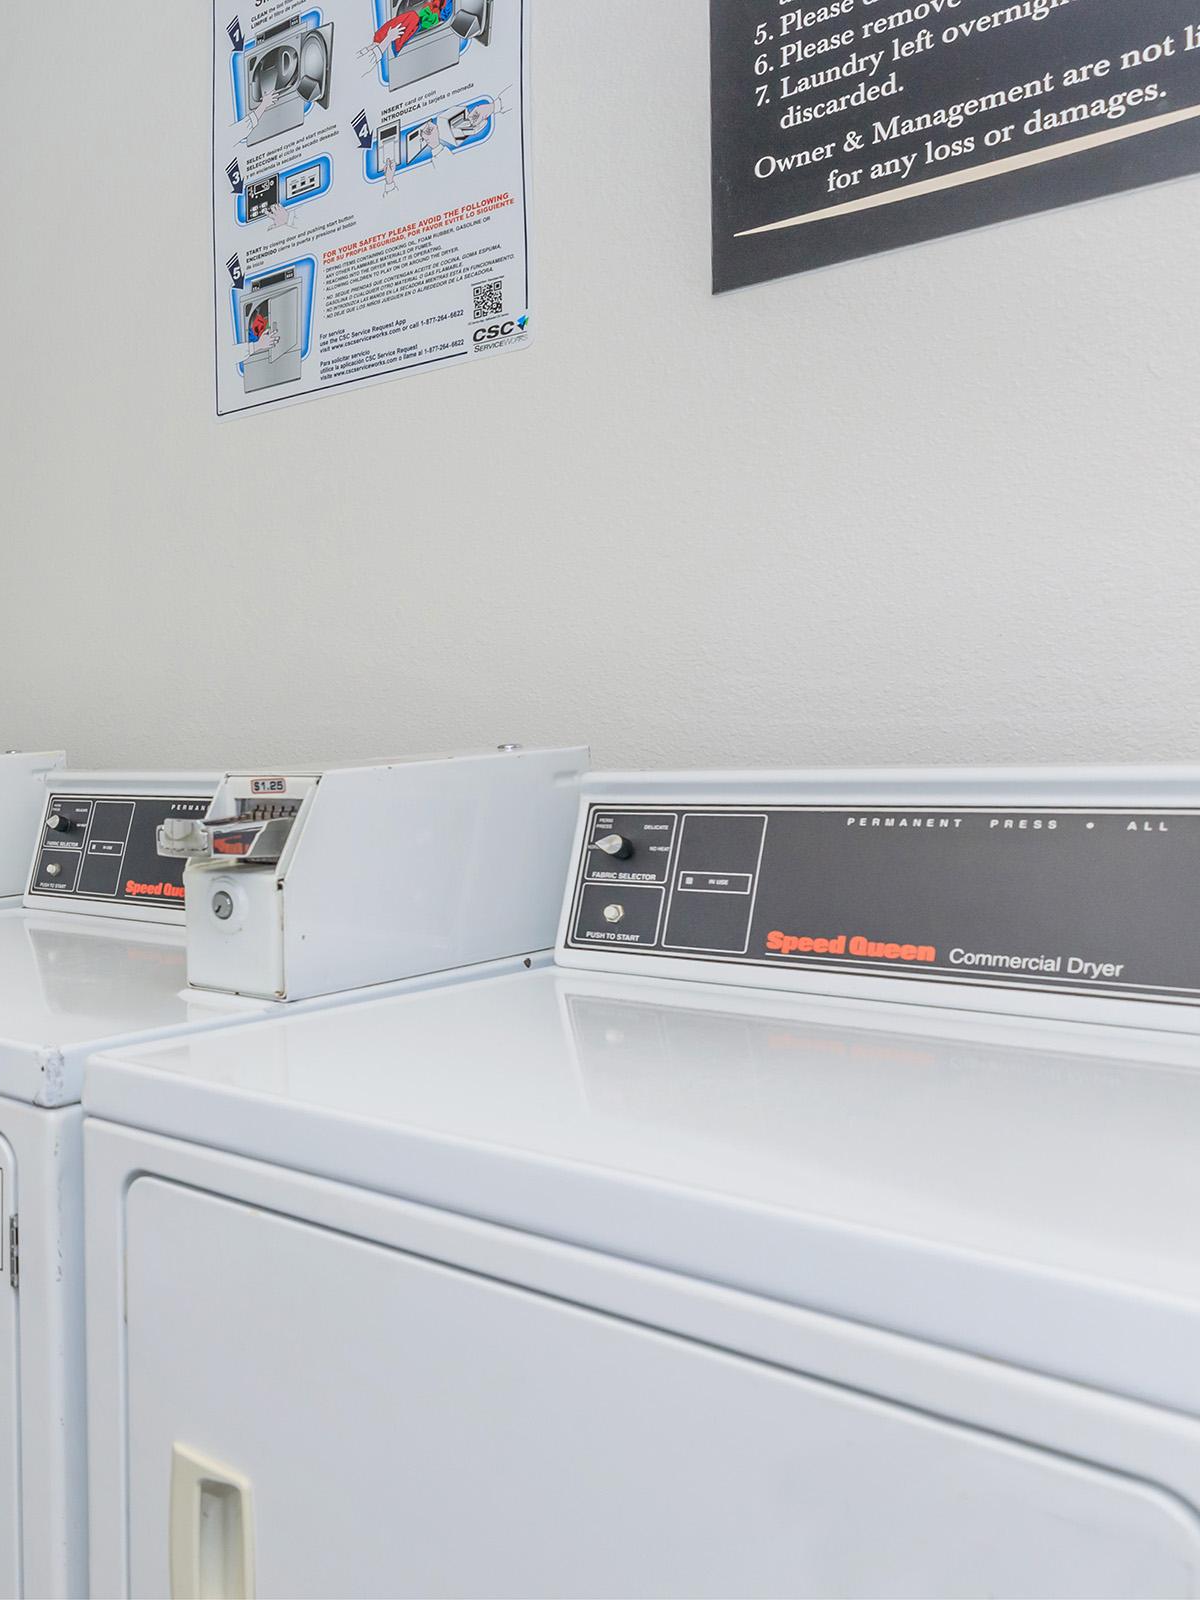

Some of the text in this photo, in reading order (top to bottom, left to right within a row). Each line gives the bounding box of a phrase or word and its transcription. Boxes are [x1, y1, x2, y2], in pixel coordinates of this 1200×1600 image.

[233, 29, 240, 42] 1
[754, 0, 854, 45] 5. Please
[754, 54, 774, 75] 6.
[780, 29, 854, 67] Please
[755, 0, 1074, 107] 7. Laundry left overnig
[381, 102, 404, 116] INSERT
[404, 97, 417, 107] card
[424, 89, 437, 99] coin
[381, 102, 421, 123] INTRODUZCA
[428, 93, 446, 105] tarjeta
[451, 82, 474, 96] moneda
[754, 142, 836, 179] Owner
[843, 130, 864, 152] &
[872, 71, 1054, 144] Management
[1062, 58, 1110, 87] are
[1120, 36, 1176, 70] not
[780, 72, 904, 129] discarded.
[358, 123, 368, 138] 4
[827, 83, 1167, 192] for any loss or damages.
[232, 171, 240, 184] 3
[322, 193, 509, 259] FOR YOUR SAFETY PLEASE AVOID THE FOLLOWING
[323, 198, 515, 265] POR SU PROPIA SEGURIDAD, POR FAVOR EVITE LO SIGUIENTE
[325, 263, 341, 273] DRYING
[342, 259, 355, 267] ITEMS
[356, 250, 384, 263] CONTAINING
[385, 242, 407, 254] COOKING
[418, 234, 432, 243] FOAM
[456, 219, 481, 231] GASOLINE
[233, 267, 240, 280] 5
[325, 274, 349, 285] REACHING
[349, 270, 360, 278] INTO
[370, 262, 387, 271] DRYER
[387, 257, 401, 266] WHILE
[326, 280, 349, 291] ALLOWING
[350, 273, 372, 284] CHILDREN
[380, 267, 392, 275] PLAY
[409, 255, 430, 266] AROUND
[335, 267, 351, 276] OTHER
[351, 258, 379, 271] FLAMMABLE
[380, 249, 406, 262] MATERIALS
[320, 345, 330, 353] visit
[331, 326, 401, 350] www.cscserviceworks.com
[409, 322, 419, 330] call
[328, 327, 345, 337] service
[339, 333, 350, 341] CSC
[351, 327, 371, 338] Service
[372, 321, 394, 333] Request
[395, 318, 407, 326] App
[473, 321, 514, 342] CSC
[320, 349, 371, 367] Para solicitar servicio
[320, 365, 334, 374] utilice
[365, 354, 376, 362] CSC
[377, 349, 395, 359] Service
[396, 343, 418, 354] Request
[320, 372, 332, 380] visite
[333, 356, 397, 377] www.cscserviceworks.com
[403, 351, 416, 360] llame
[254, 781, 283, 791] $1.25
[846, 817, 1168, 831] PERMANENT PRESS ALL
[125, 880, 163, 895] Speed
[591, 871, 657, 881] FABRIC SELECTOR
[586, 931, 640, 942] PUSH TO START
[766, 930, 1124, 979] Speed Queen Commercial Dryer
